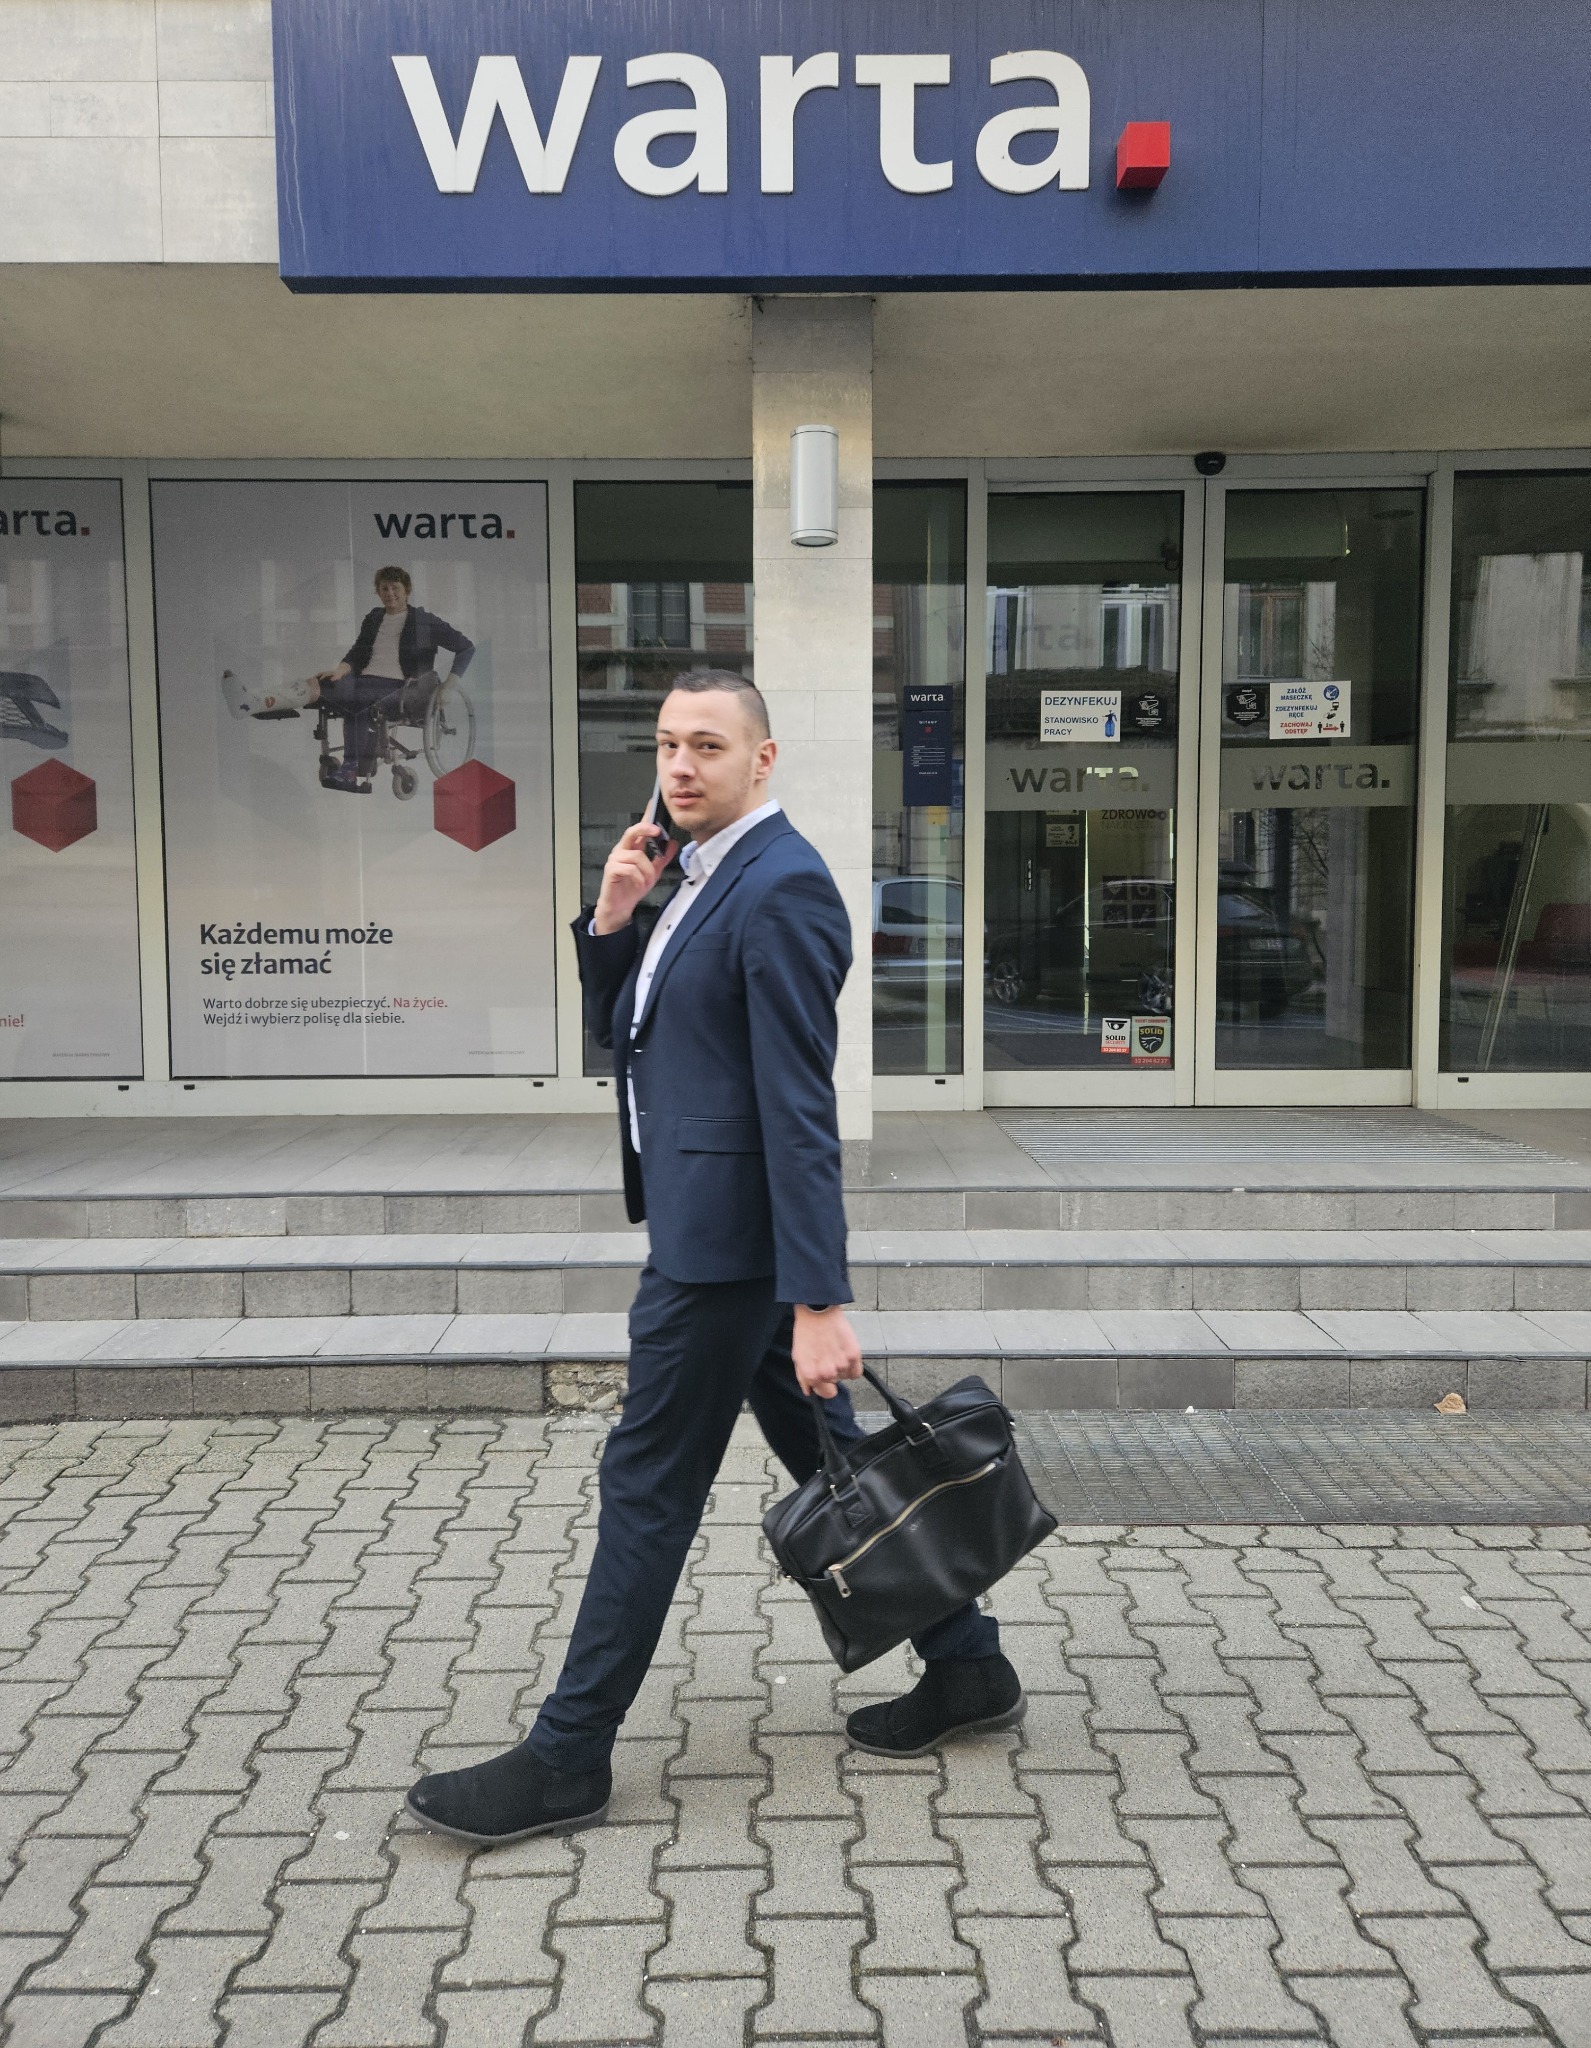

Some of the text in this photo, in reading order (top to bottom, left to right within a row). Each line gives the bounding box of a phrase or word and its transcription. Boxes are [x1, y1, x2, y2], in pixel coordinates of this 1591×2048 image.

[1044, 696, 1118, 706] DEZYNFEKUJ
[1044, 716, 1099, 724] STANOWISKO
[1044, 728, 1072, 736] PRACY
[200, 922, 393, 945] Każdemu może
[201, 950, 332, 981] się złamać
[203, 996, 448, 1012] Warto dobrze się ubezpieczyć. Na życie.
[203, 1013, 243, 1028] Wejdź
[251, 1012, 301, 1027] wybierz
[303, 1012, 341, 1027] polisę
[343, 1012, 362, 1024] dla
[365, 1012, 405, 1024] siebie.
[1140, 1027, 1163, 1035] SOLID
